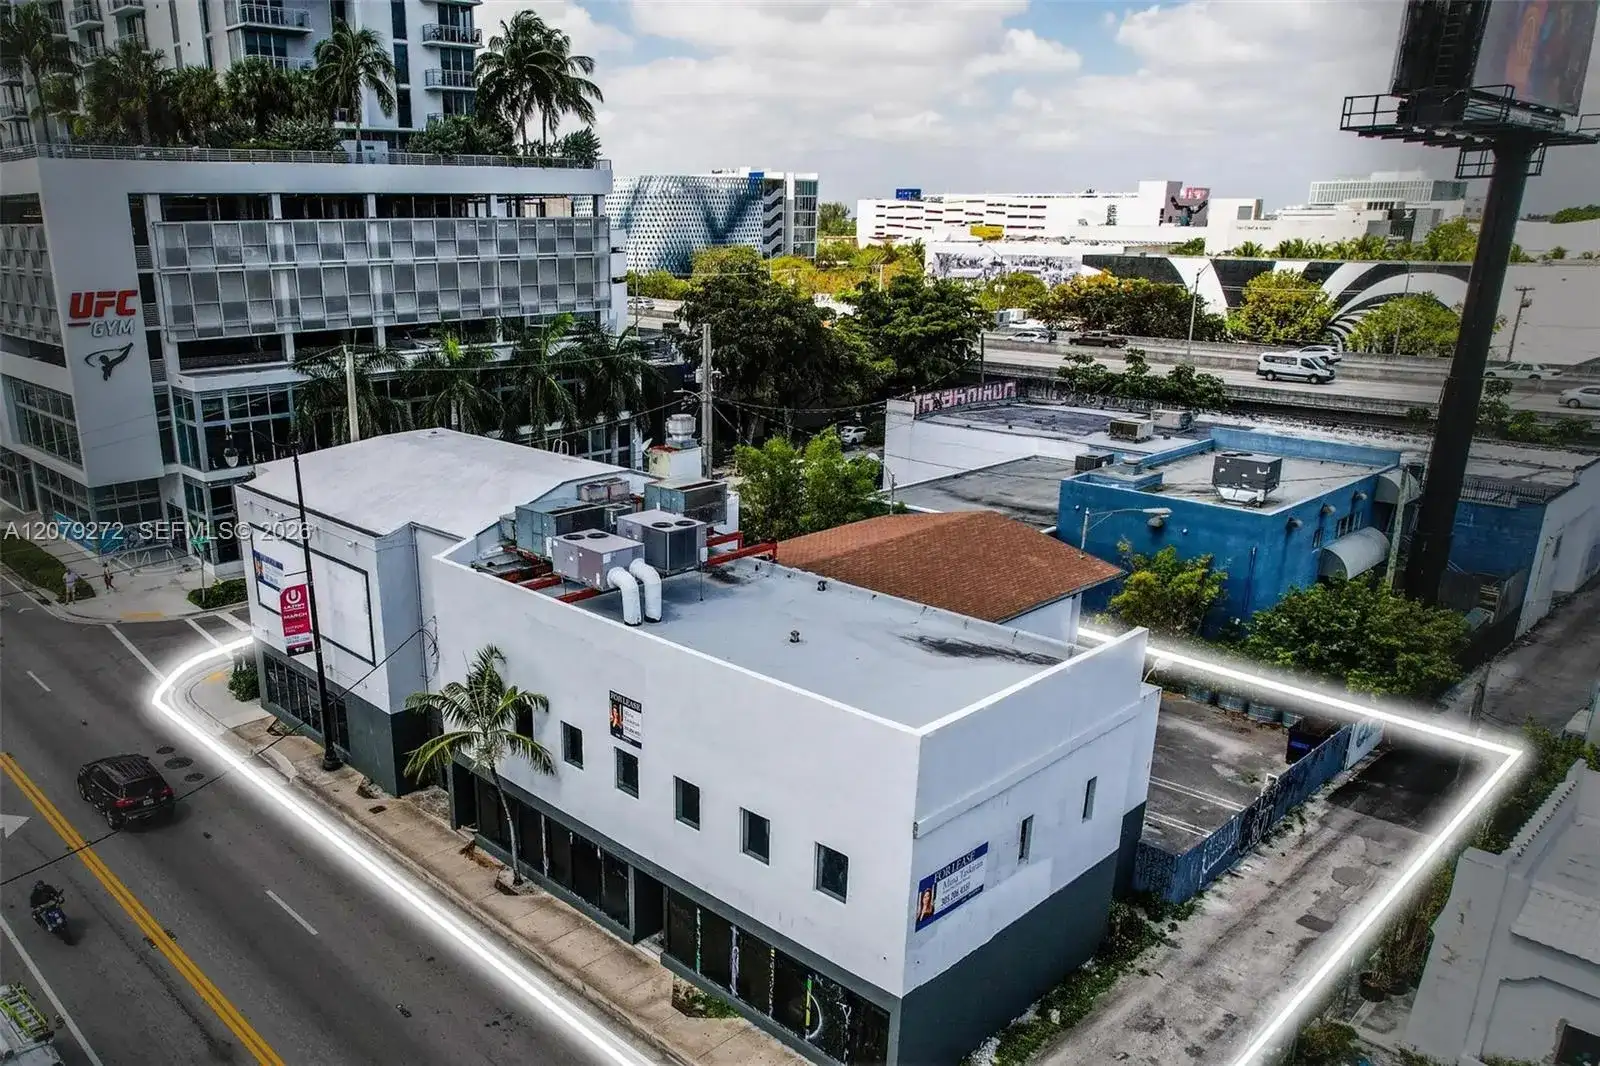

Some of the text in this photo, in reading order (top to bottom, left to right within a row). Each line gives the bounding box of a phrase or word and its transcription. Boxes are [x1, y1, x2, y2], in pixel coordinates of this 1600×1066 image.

[70, 290, 138, 319] UFC
[91, 319, 135, 338] GYM
[935, 866, 951, 884] FOR
[952, 851, 976, 873] LEASE
